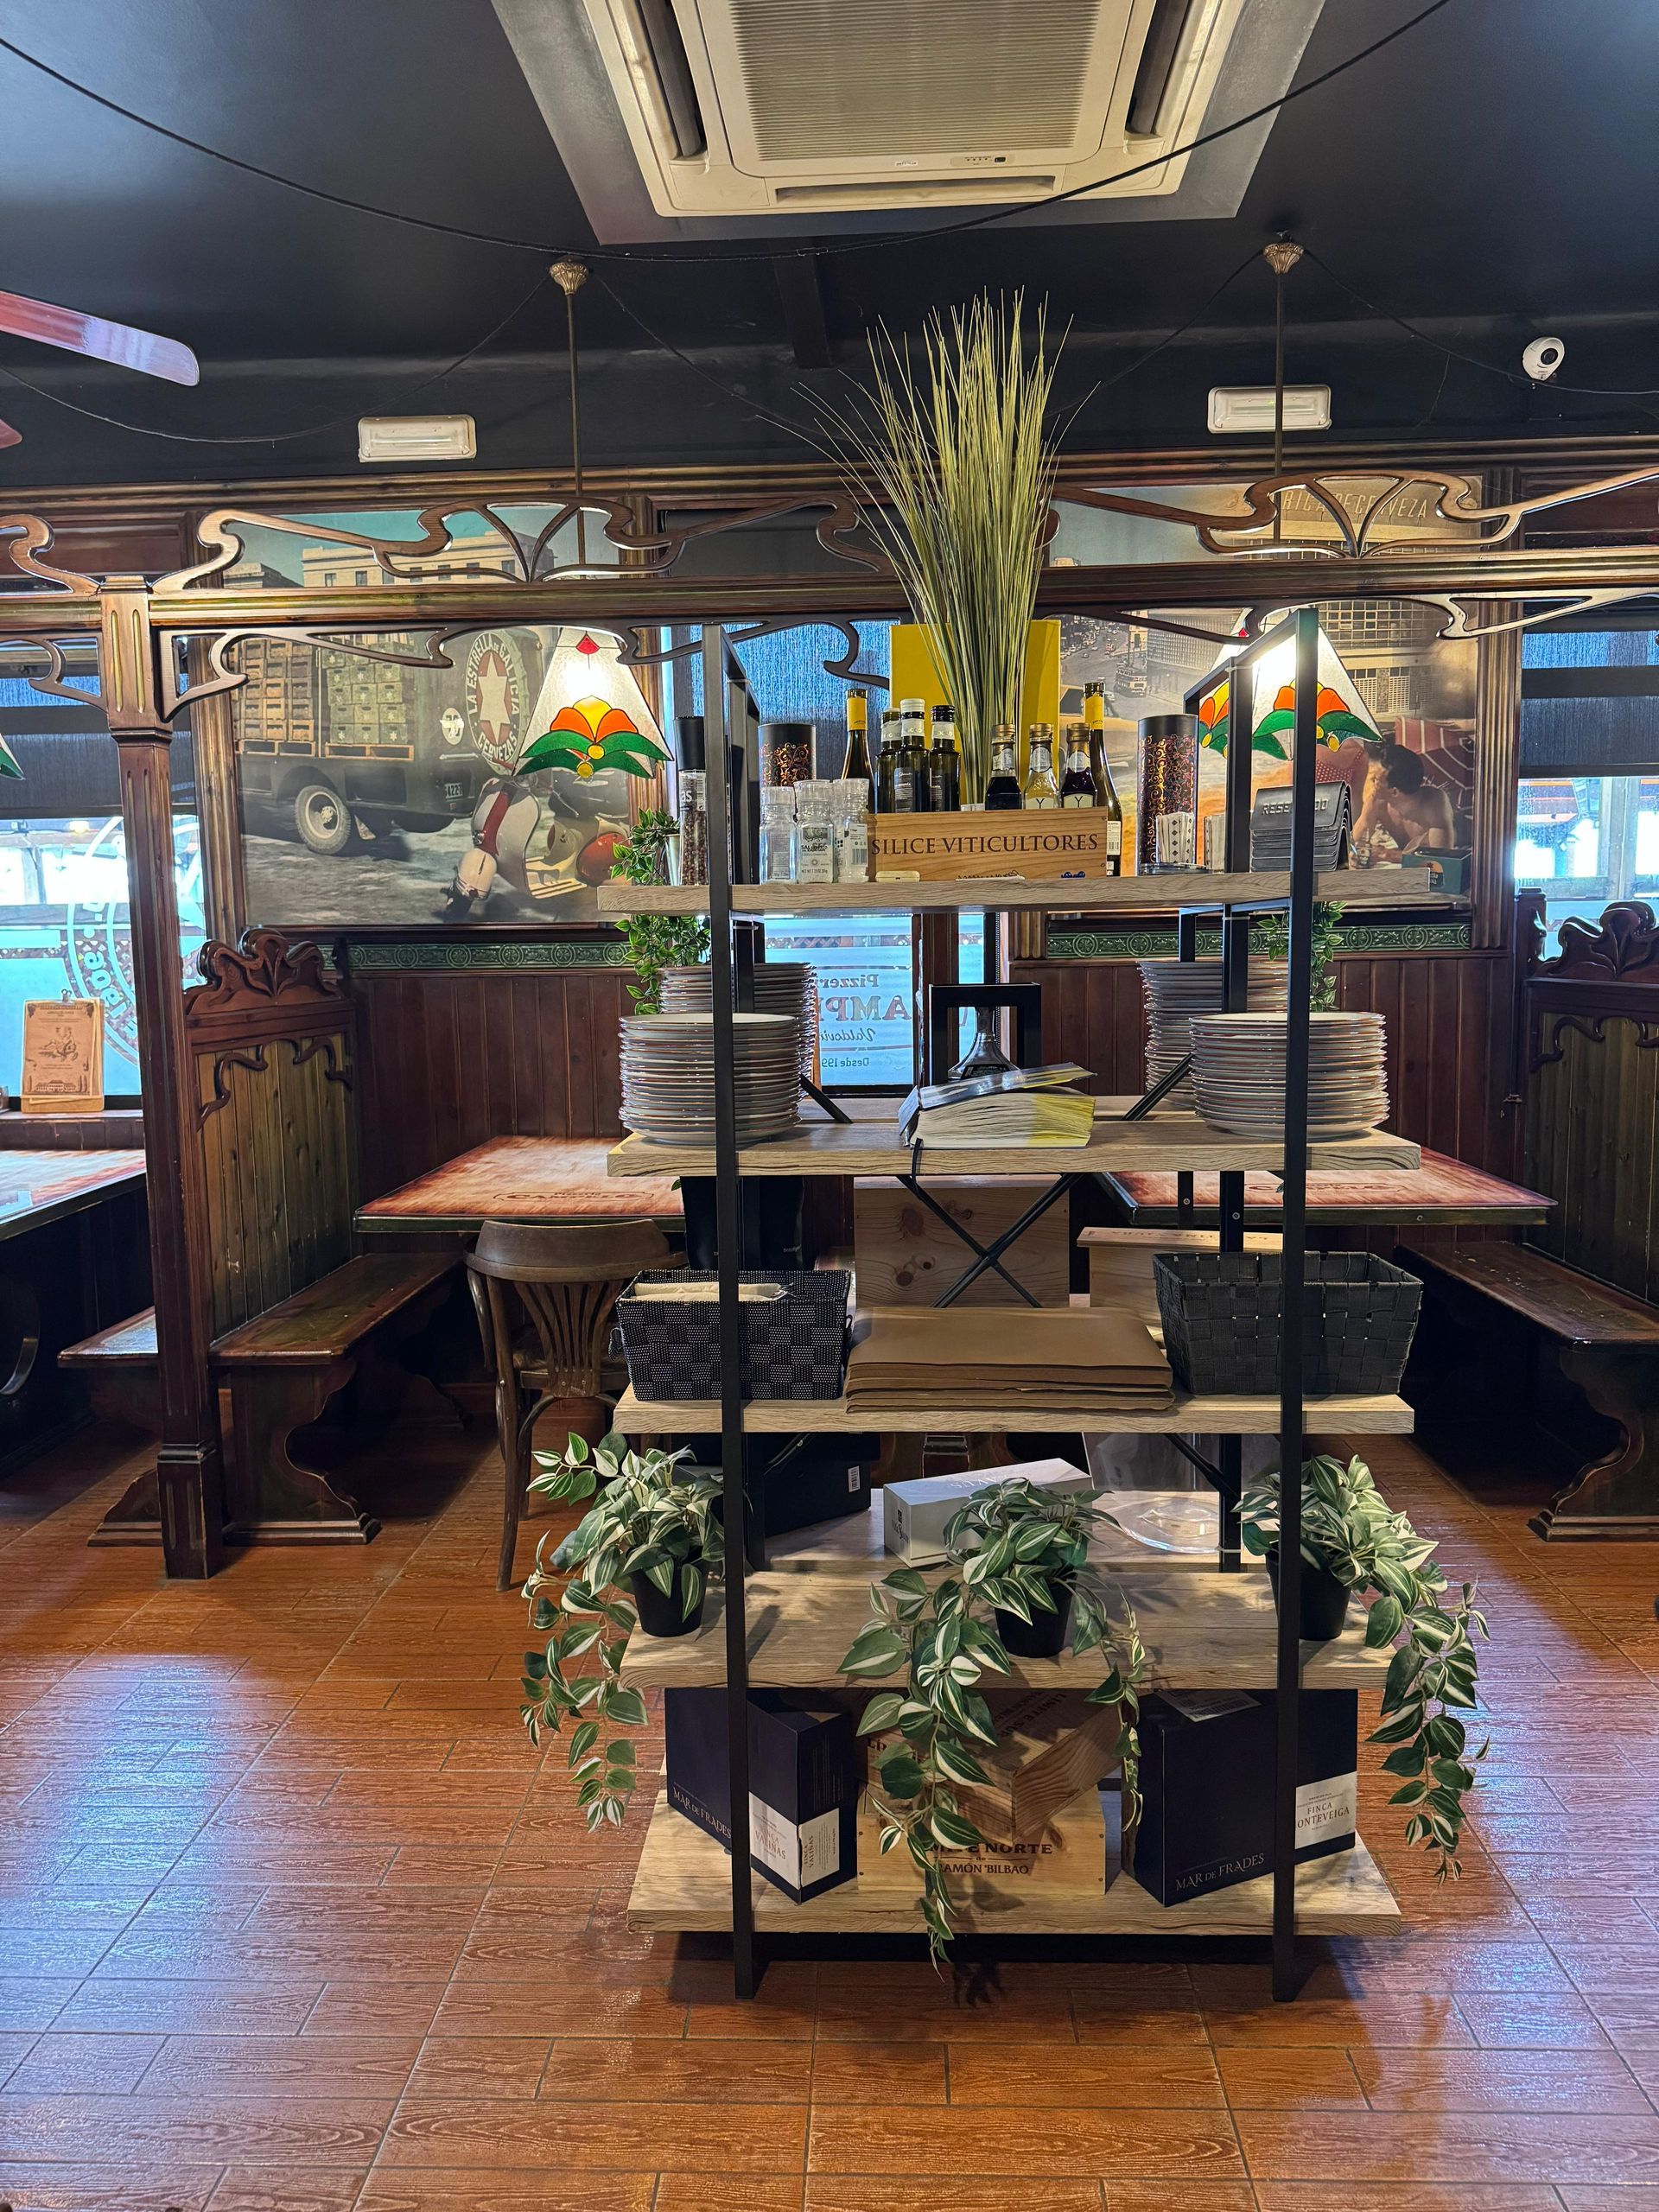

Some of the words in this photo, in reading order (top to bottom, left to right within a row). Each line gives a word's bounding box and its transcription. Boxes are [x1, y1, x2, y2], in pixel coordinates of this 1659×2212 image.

[1354, 494, 1427, 518] CEVEZA
[467, 632, 493, 690] ESTRELLA
[499, 644, 520, 716] GALICIA
[467, 695, 478, 715] LA
[1262, 799, 1329, 815] RESEDO
[871, 837, 936, 855] SILICE
[942, 834, 1098, 854] VITICULTORES
[672, 1787, 692, 1811] MAR
[700, 1808, 732, 1840] FRADES
[1297, 1806, 1350, 1829] ONTEVEIGA
[1306, 1802, 1332, 1815] FINCA
[985, 1843, 1052, 1854] NORTE
[942, 1863, 982, 1873] AMÓN
[1175, 1872, 1203, 1891] MAR
[1218, 1852, 1265, 1878] FRADES
